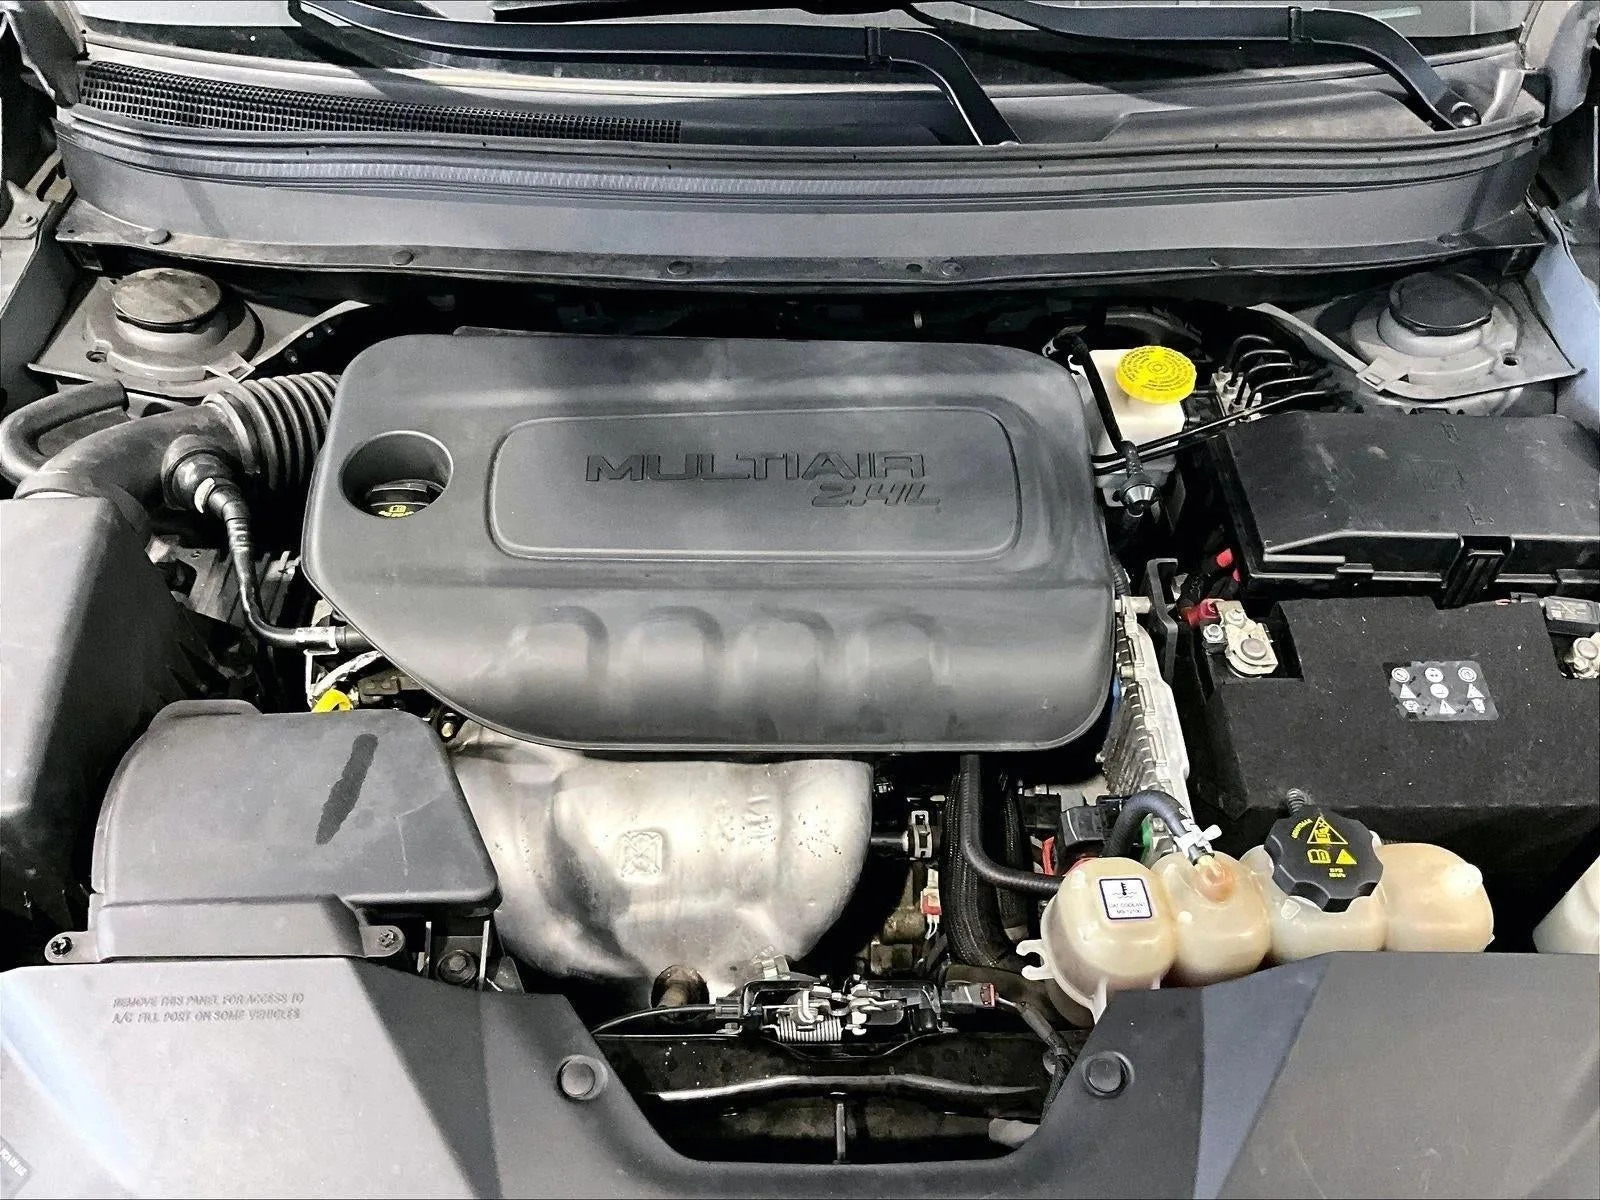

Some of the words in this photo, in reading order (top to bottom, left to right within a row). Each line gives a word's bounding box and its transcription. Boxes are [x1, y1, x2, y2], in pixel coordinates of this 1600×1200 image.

[586, 452, 926, 482] MULTIAIR
[811, 482, 941, 507] 2.4L
[113, 996, 158, 1008] REMOVE
[161, 995, 184, 1007] THIS
[186, 995, 218, 1006] PANEL
[222, 994, 243, 1005] FOR
[246, 993, 288, 1005] ACCESS
[291, 992, 304, 1004] TO
[112, 1011, 132, 1024] A/C
[138, 1011, 160, 1023] FILL
[163, 1011, 191, 1022] PORT
[194, 1010, 211, 1022] ON
[214, 1009, 245, 1021] SOME
[249, 1008, 300, 1020] VEHICLES
